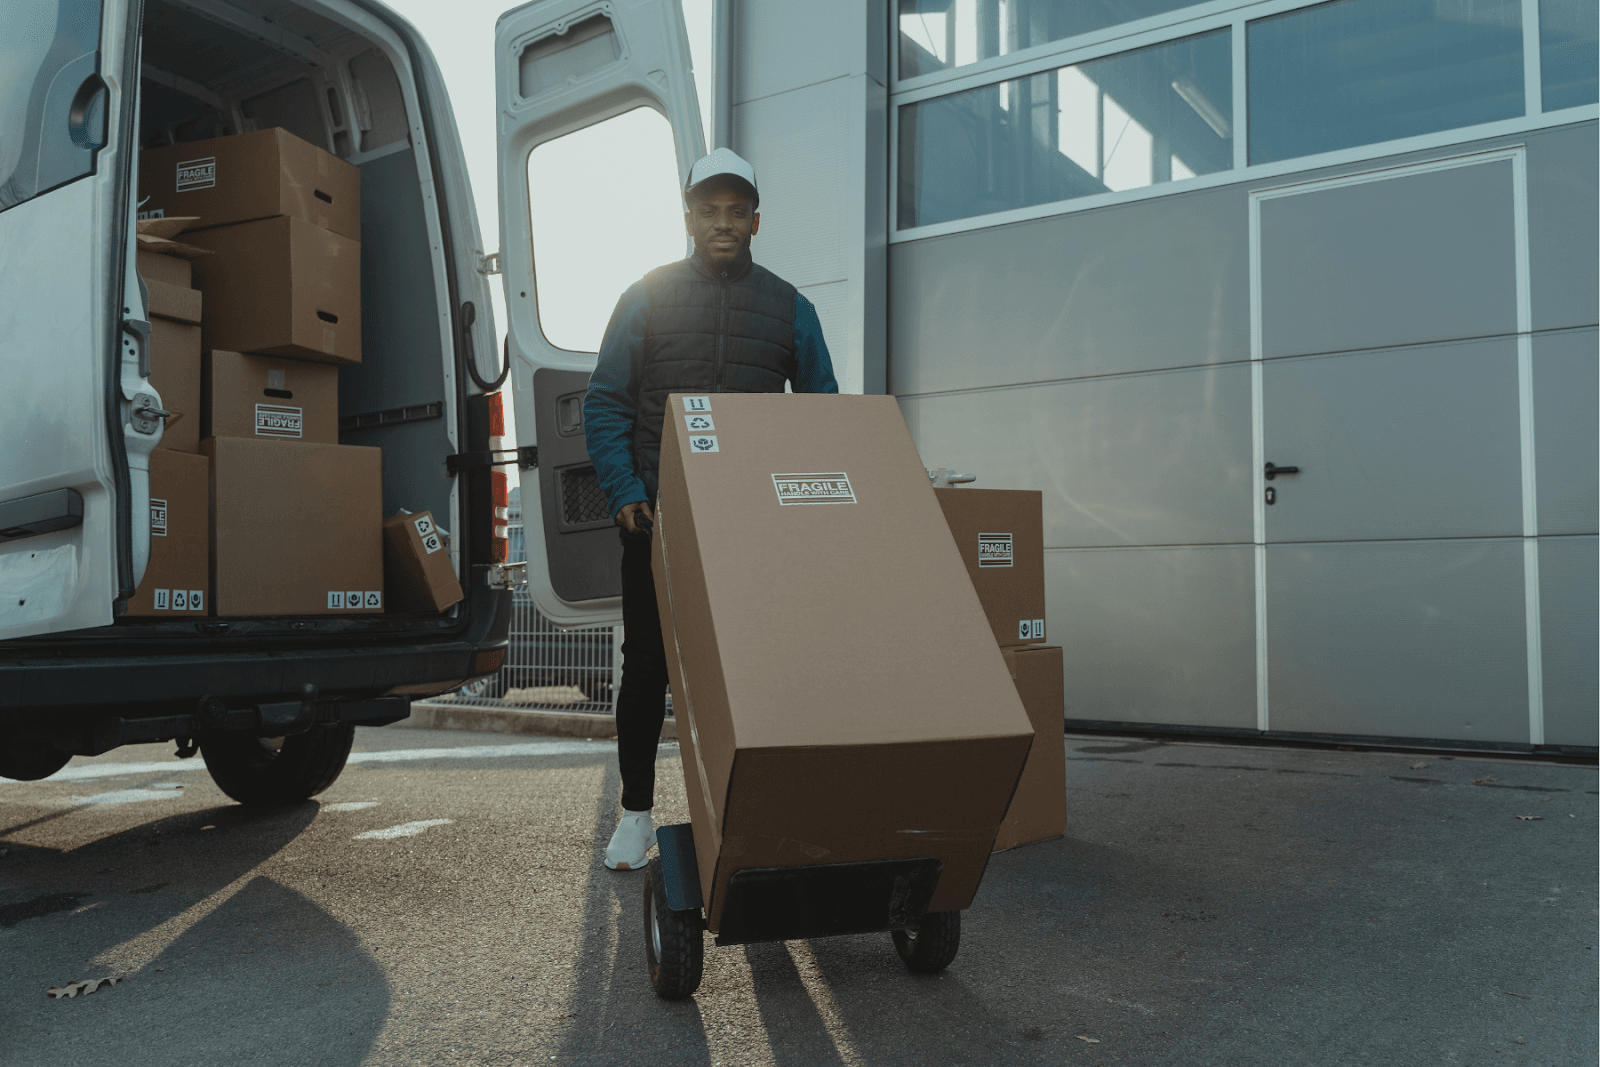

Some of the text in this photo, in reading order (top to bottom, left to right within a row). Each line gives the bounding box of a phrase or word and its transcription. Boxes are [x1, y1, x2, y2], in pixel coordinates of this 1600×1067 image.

[178, 166, 213, 180] FRAGILE
[258, 417, 300, 428] FRAGILE
[778, 482, 849, 492] FRAGILE
[980, 544, 1010, 553] FRAGILE
